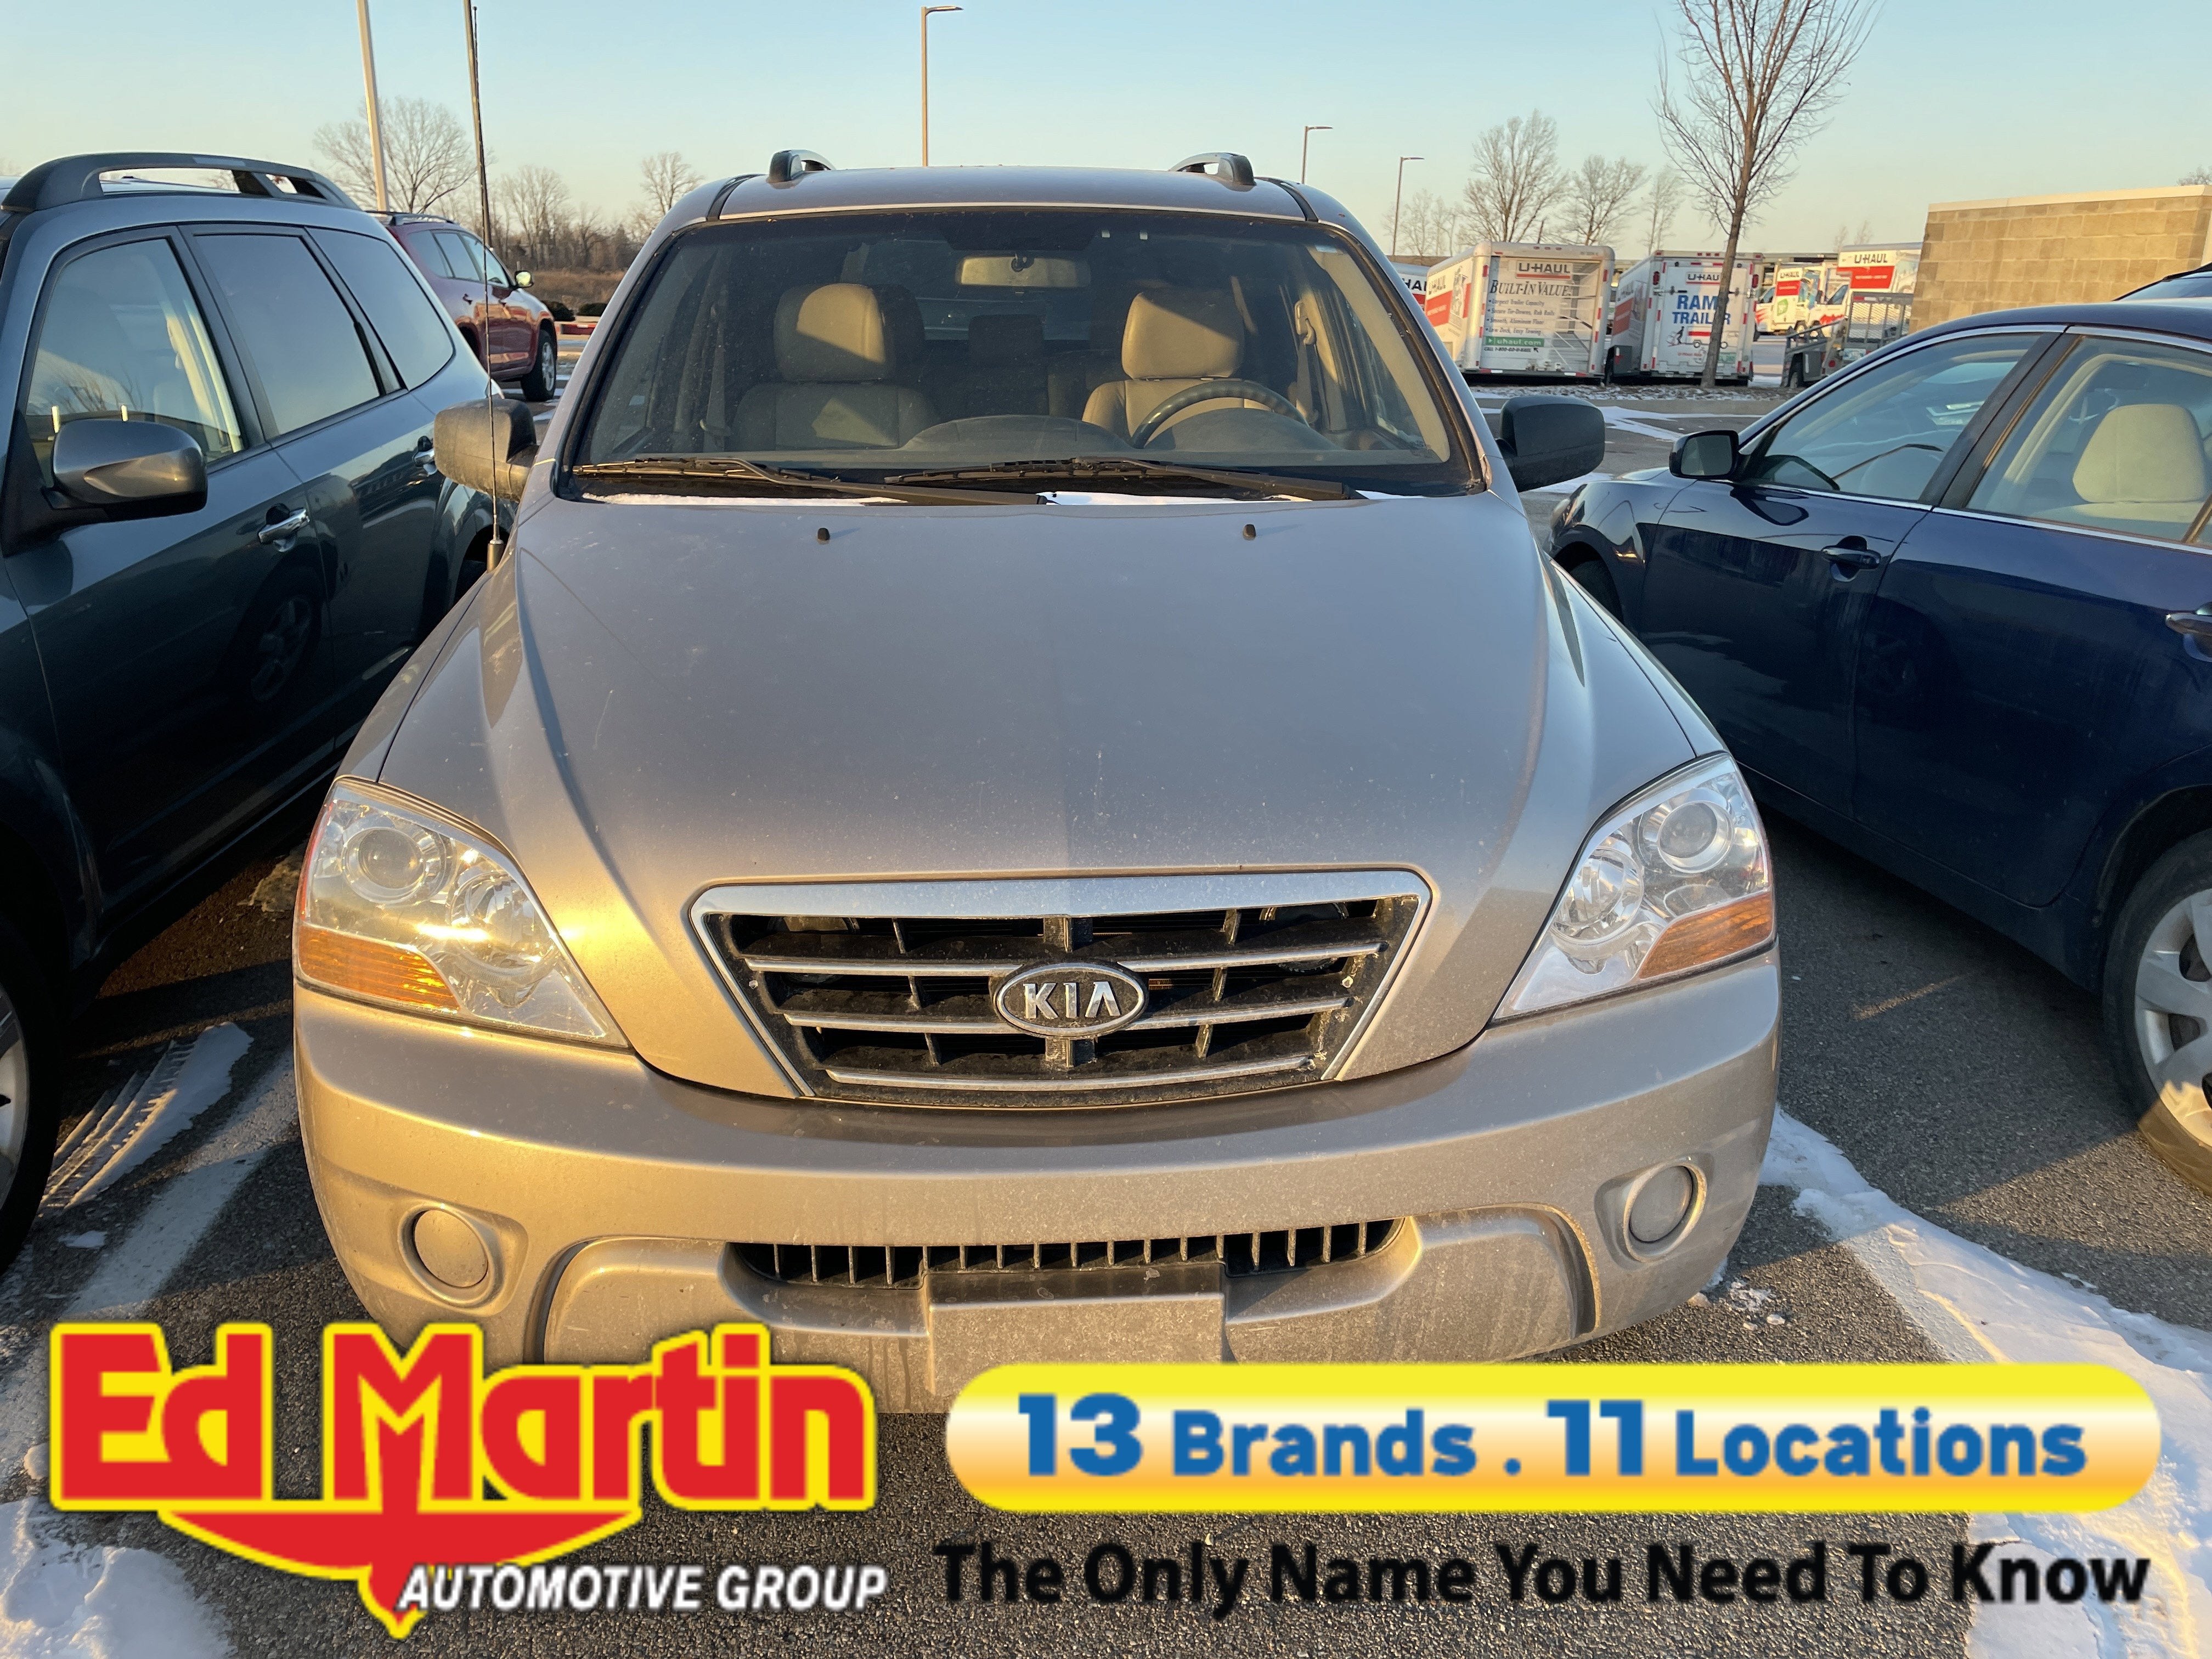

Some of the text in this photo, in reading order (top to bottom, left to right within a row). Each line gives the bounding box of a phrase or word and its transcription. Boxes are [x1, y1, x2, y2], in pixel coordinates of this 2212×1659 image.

[1854, 253, 1887, 263] U-HAUL
[1519, 263, 1570, 273] U-HAUL
[1489, 280, 1536, 295] BUILT-IN
[1677, 295, 1729, 309] RAM
[1673, 312, 1730, 324] TRAILR
[1023, 981, 1121, 1019] KIA
